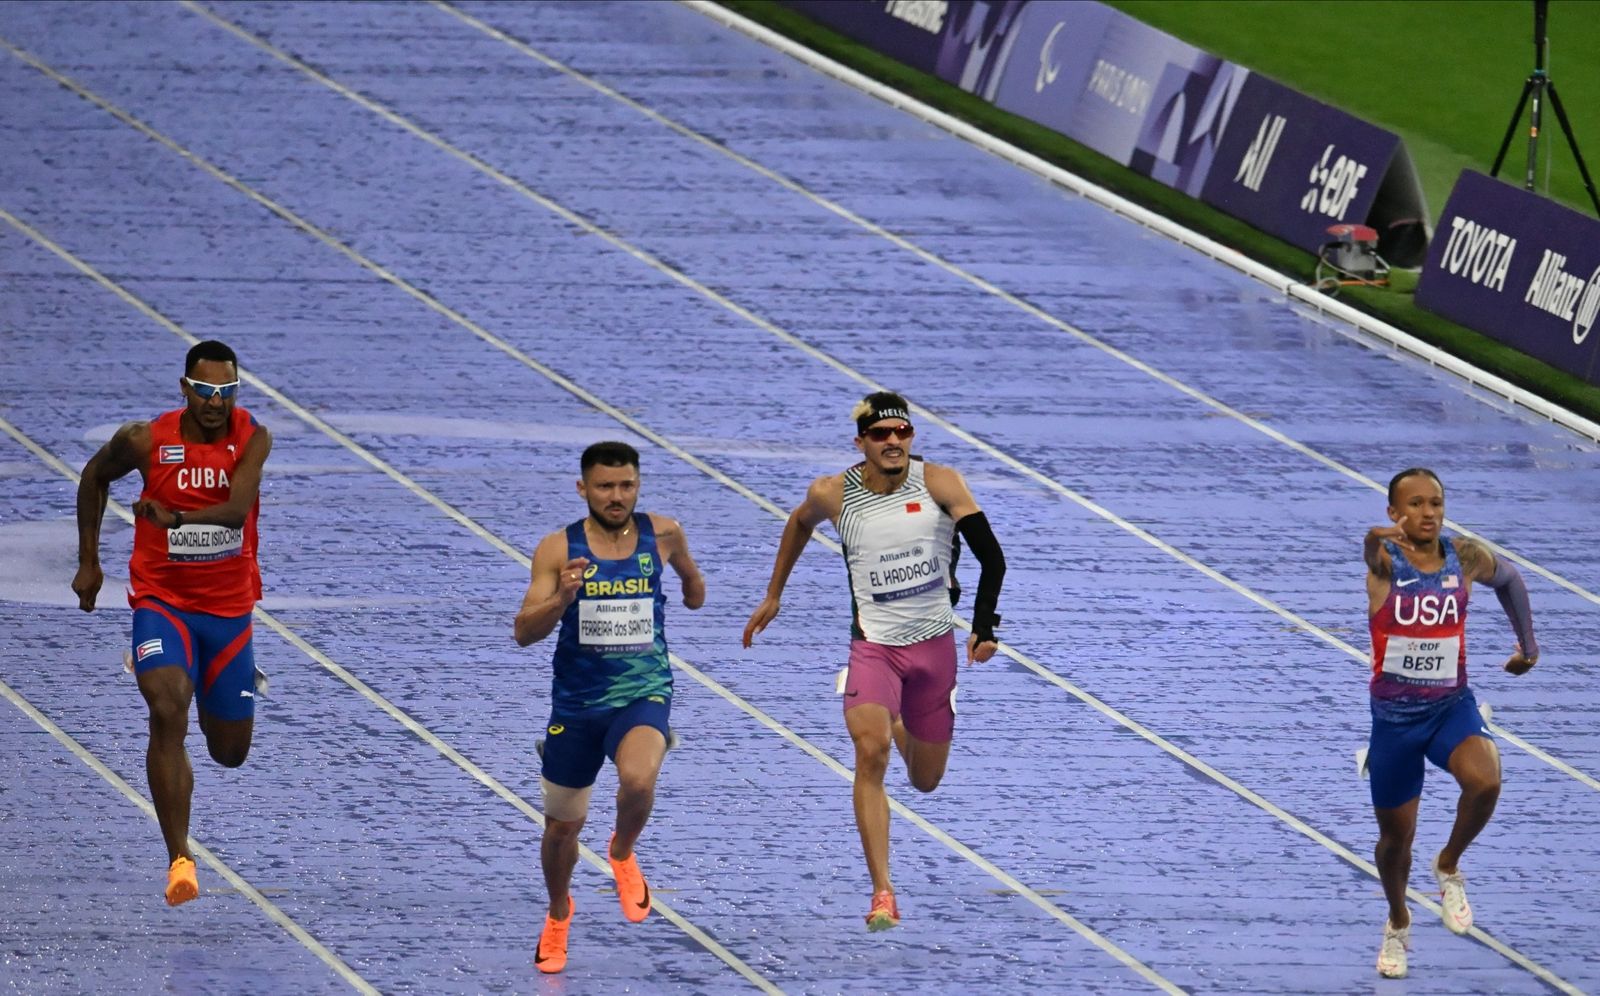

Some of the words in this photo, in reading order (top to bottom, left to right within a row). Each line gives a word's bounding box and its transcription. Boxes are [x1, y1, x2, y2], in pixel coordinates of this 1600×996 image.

[1440, 216, 1517, 292] TOYOTA
[1524, 248, 1586, 322] Allianz
[177, 467, 230, 490] CUBA
[880, 551, 911, 563] Allianz
[869, 571, 882, 587] EL
[883, 556, 940, 585] HADDAOUI
[585, 578, 653, 597] BRASIL
[595, 604, 628, 613] Allianz
[1394, 594, 1459, 626] USA
[581, 620, 613, 637] FERREIRA
[613, 620, 627, 636] dos
[628, 618, 652, 636] SANTOS
[1402, 655, 1445, 671] BEST
